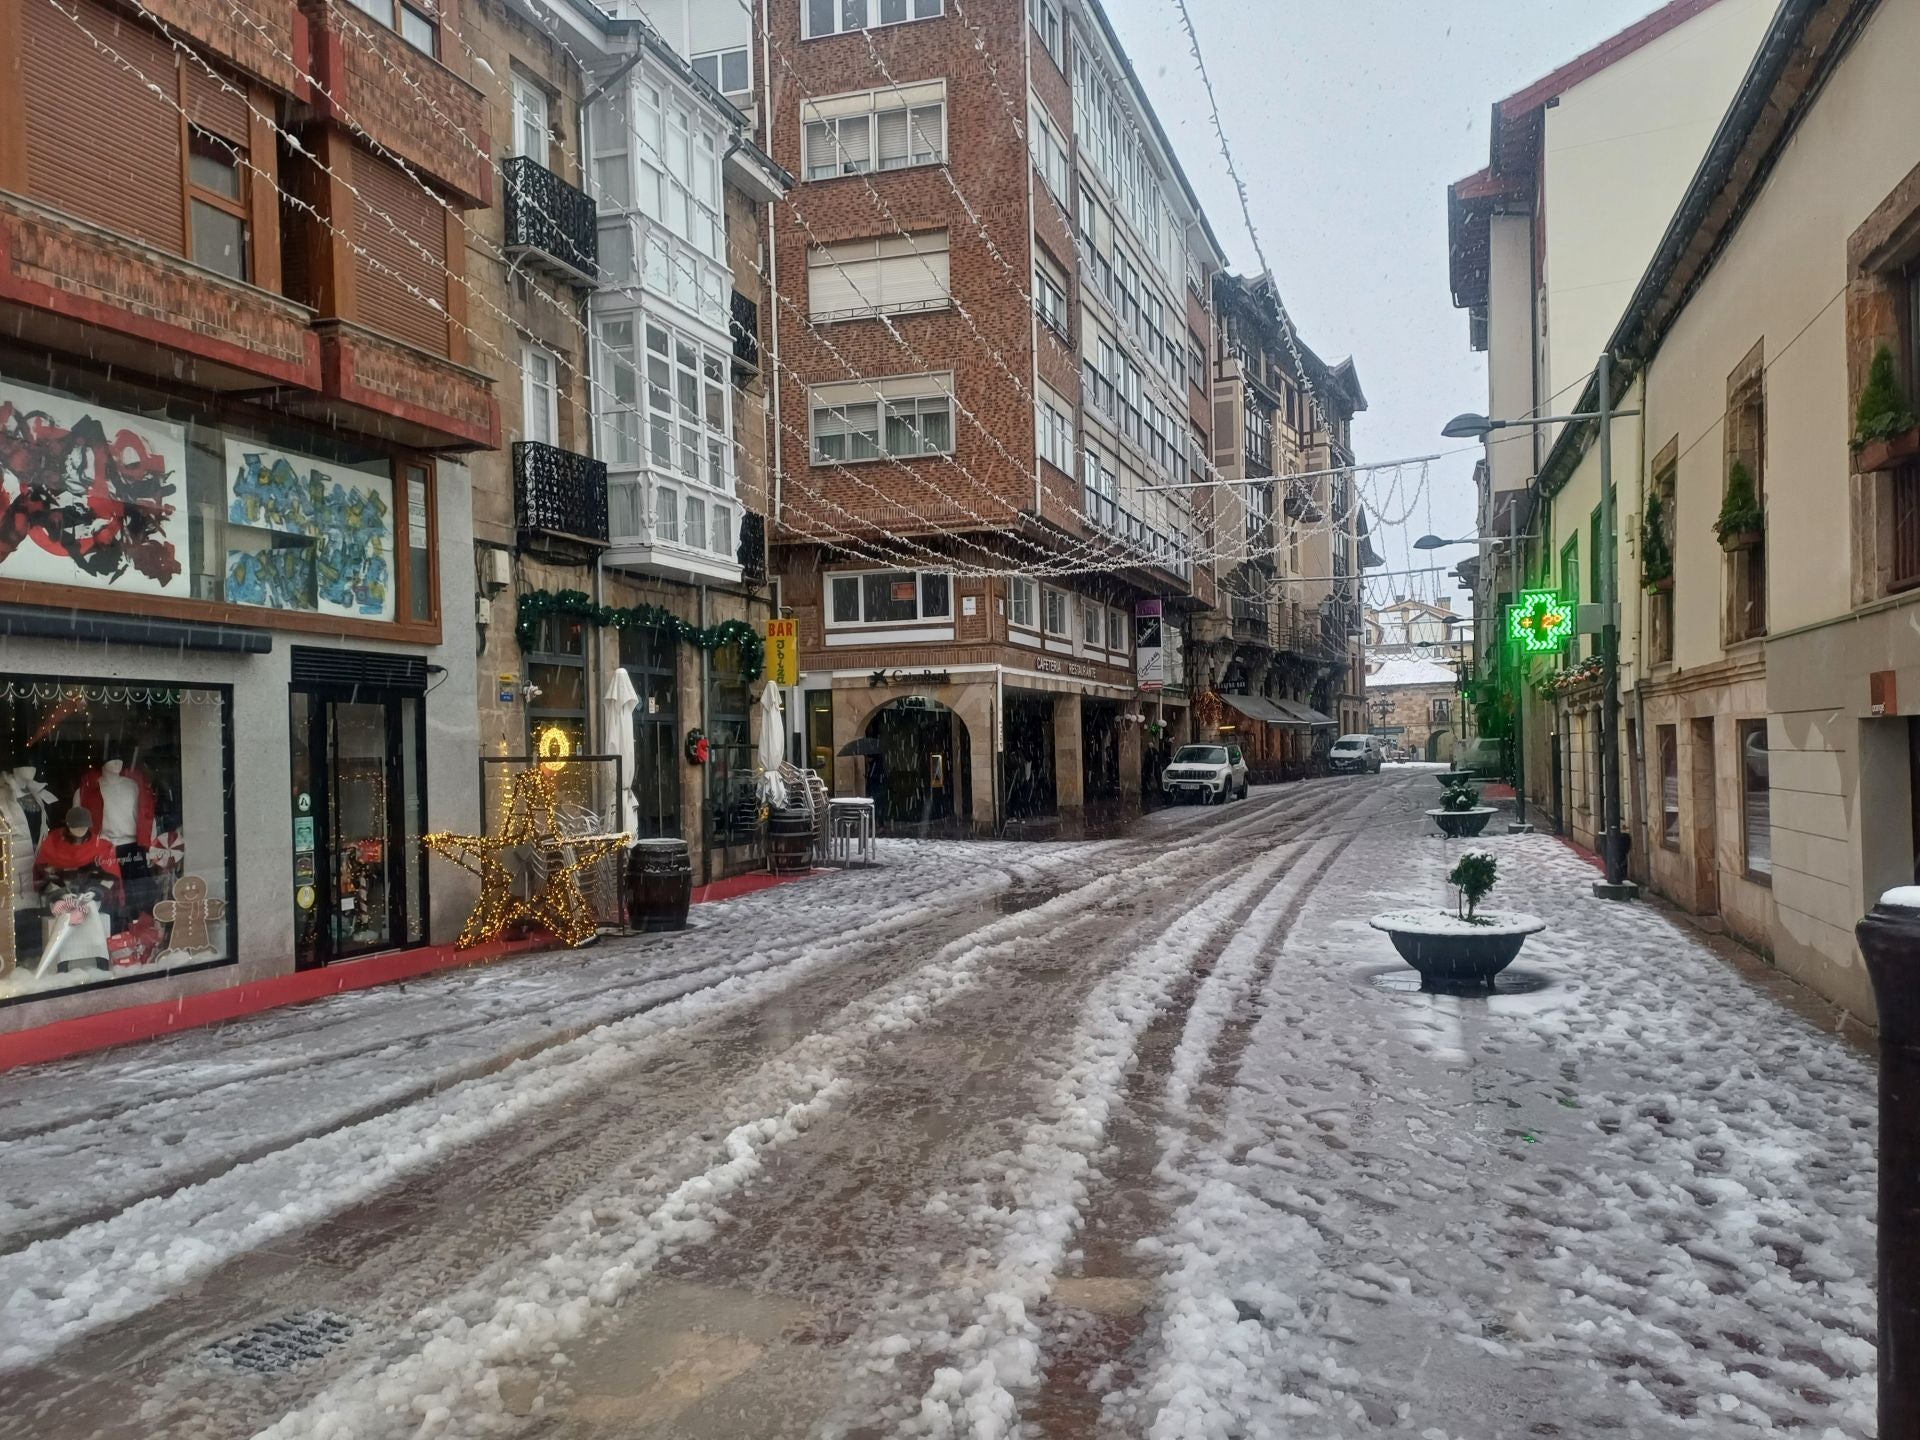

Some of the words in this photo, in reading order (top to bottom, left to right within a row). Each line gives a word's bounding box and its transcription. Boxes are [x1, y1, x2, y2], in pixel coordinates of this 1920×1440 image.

[768, 622, 793, 637] BAR
[1036, 656, 1062, 673] CAFETERIA
[1068, 662, 1097, 679] RESTAURANTE
